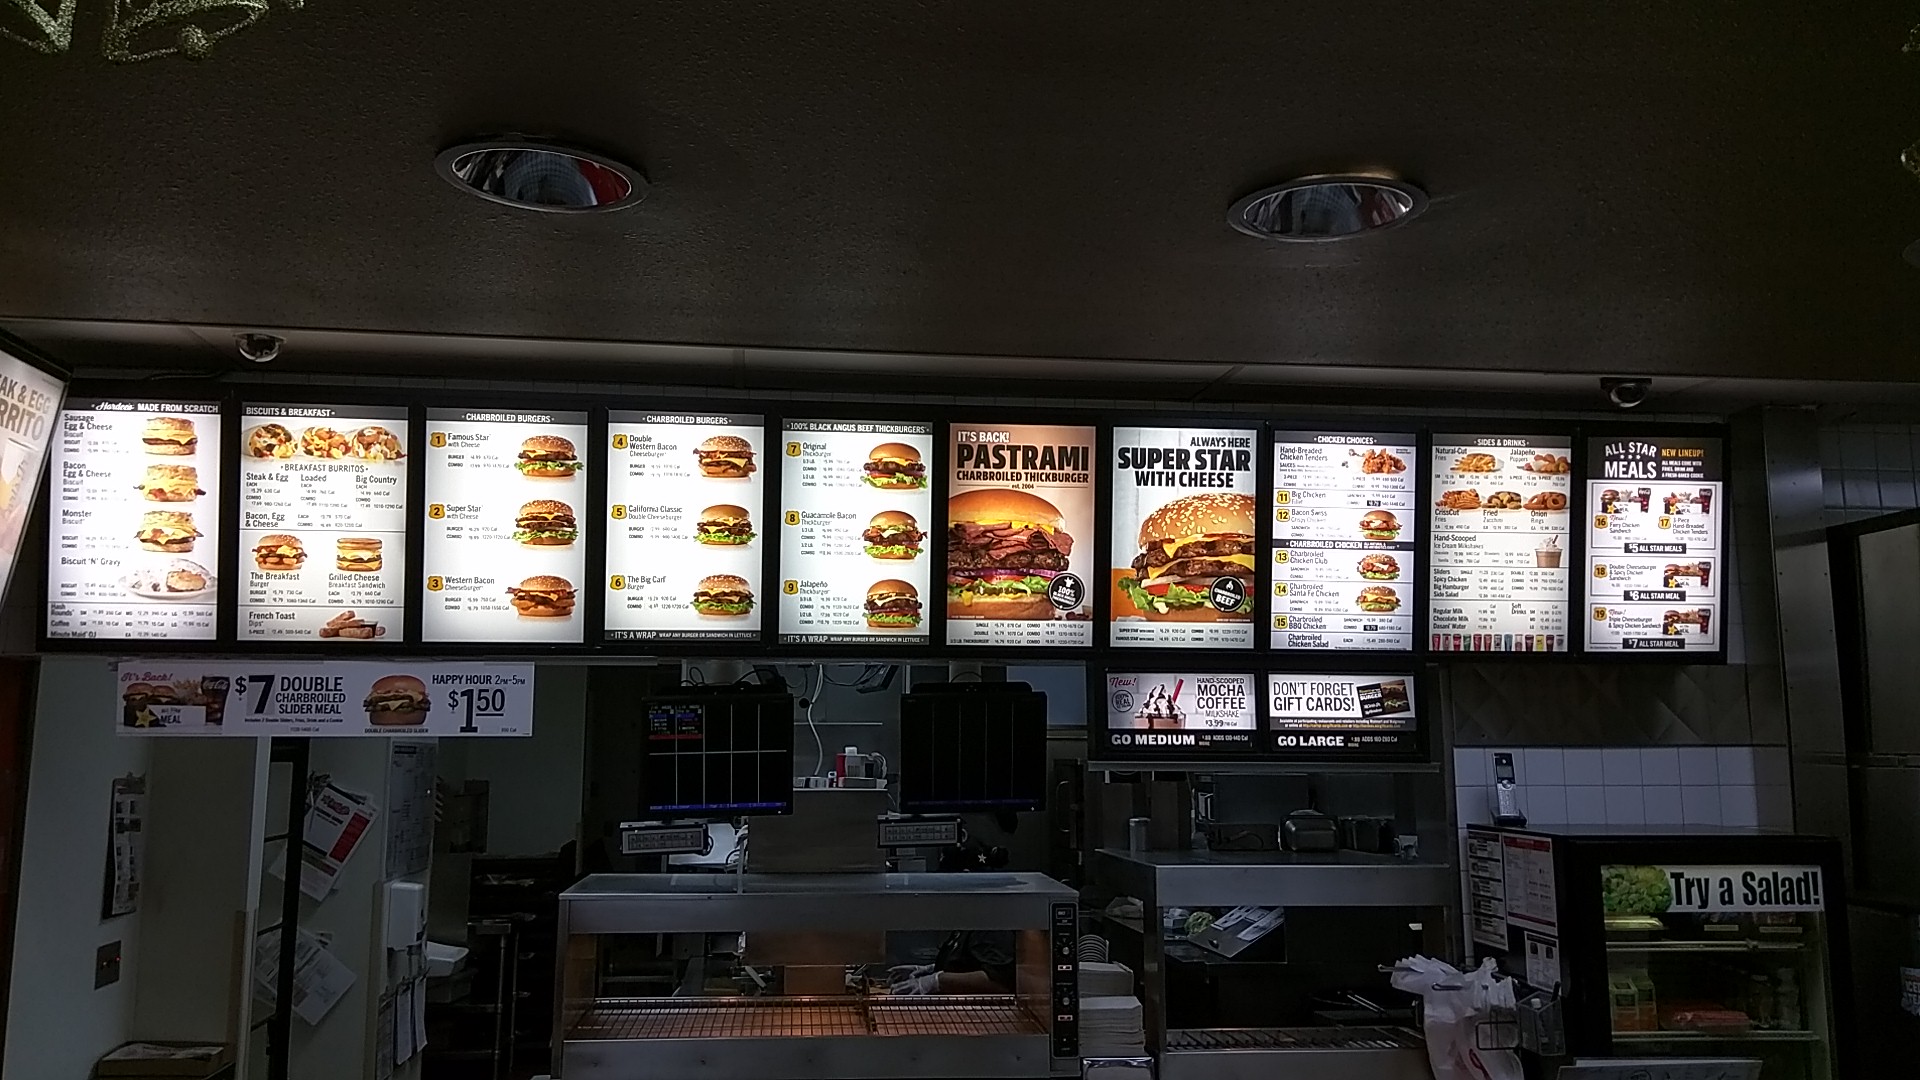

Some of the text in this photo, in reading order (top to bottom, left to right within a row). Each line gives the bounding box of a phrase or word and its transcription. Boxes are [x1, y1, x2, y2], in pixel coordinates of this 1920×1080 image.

[0, 373, 52, 414] AK & EGG
[137, 404, 160, 412] MADE
[161, 404, 183, 412] FROM
[184, 405, 218, 413] SCRATCH
[246, 407, 279, 415] BISCUITS
[64, 414, 94, 423] Sausage
[466, 413, 516, 422] CHARBROILED
[646, 415, 728, 424] CHARBROILED BURGERS
[64, 422, 77, 430] Egg
[436, 436, 441, 445] 1
[617, 437, 624, 446] 4
[958, 432, 1010, 442] IT'S BACK!
[802, 442, 826, 451] Original
[1190, 436, 1250, 448] ALWAYS HERE
[791, 445, 797, 453] 7
[1605, 441, 1657, 457] ALL STAR
[1661, 448, 1704, 457] NEW LINEUP!
[957, 444, 1089, 471] PASTRAMI
[1118, 447, 1251, 471] SUPER STAR
[63, 461, 86, 469] Bacon
[284, 464, 364, 473] BREAKFAST BURRITOS
[1604, 461, 1657, 479] MEALS
[246, 473, 266, 481] Steak
[276, 474, 288, 482] Egg
[356, 475, 397, 485] Big Country
[957, 471, 1089, 483] CHARBROILED THICKBURGER
[1135, 471, 1234, 488] WITH CHEESE
[434, 507, 440, 516] 2
[616, 508, 623, 516] 5
[1279, 512, 1288, 520] 12
[246, 512, 285, 522] Bacon, Egg
[789, 514, 795, 522] 8
[1629, 544, 1638, 552] $5
[265, 572, 300, 580] Breakfast
[328, 573, 352, 581] Grilled
[445, 576, 472, 584] Western
[432, 579, 439, 588] 3
[616, 578, 621, 586] 6
[788, 583, 794, 592] 9
[1630, 591, 1639, 600] $6
[249, 611, 274, 620] French
[1276, 618, 1286, 626] 15
[1629, 639, 1638, 648] $7
[121, 672, 173, 682] It's Back!
[432, 675, 525, 685] HAPPY HOUR 2PM-5PM
[280, 677, 343, 692] DOUBLE
[1110, 677, 1137, 688] New!
[1197, 684, 1245, 696] MOCHA
[1274, 682, 1354, 696] DON'T FORGET
[235, 674, 275, 714] $7
[276, 693, 346, 703] CHARBROILED
[1197, 697, 1246, 709] COFFEE
[1274, 697, 1302, 711] GIFT
[1306, 697, 1355, 711] CARDS!
[279, 704, 341, 714] SLIDER MEAL
[1111, 734, 1195, 745] GO MEDIUM
[1278, 736, 1344, 746] GO LARGE
[1670, 871, 1820, 909] Try a Salad!
